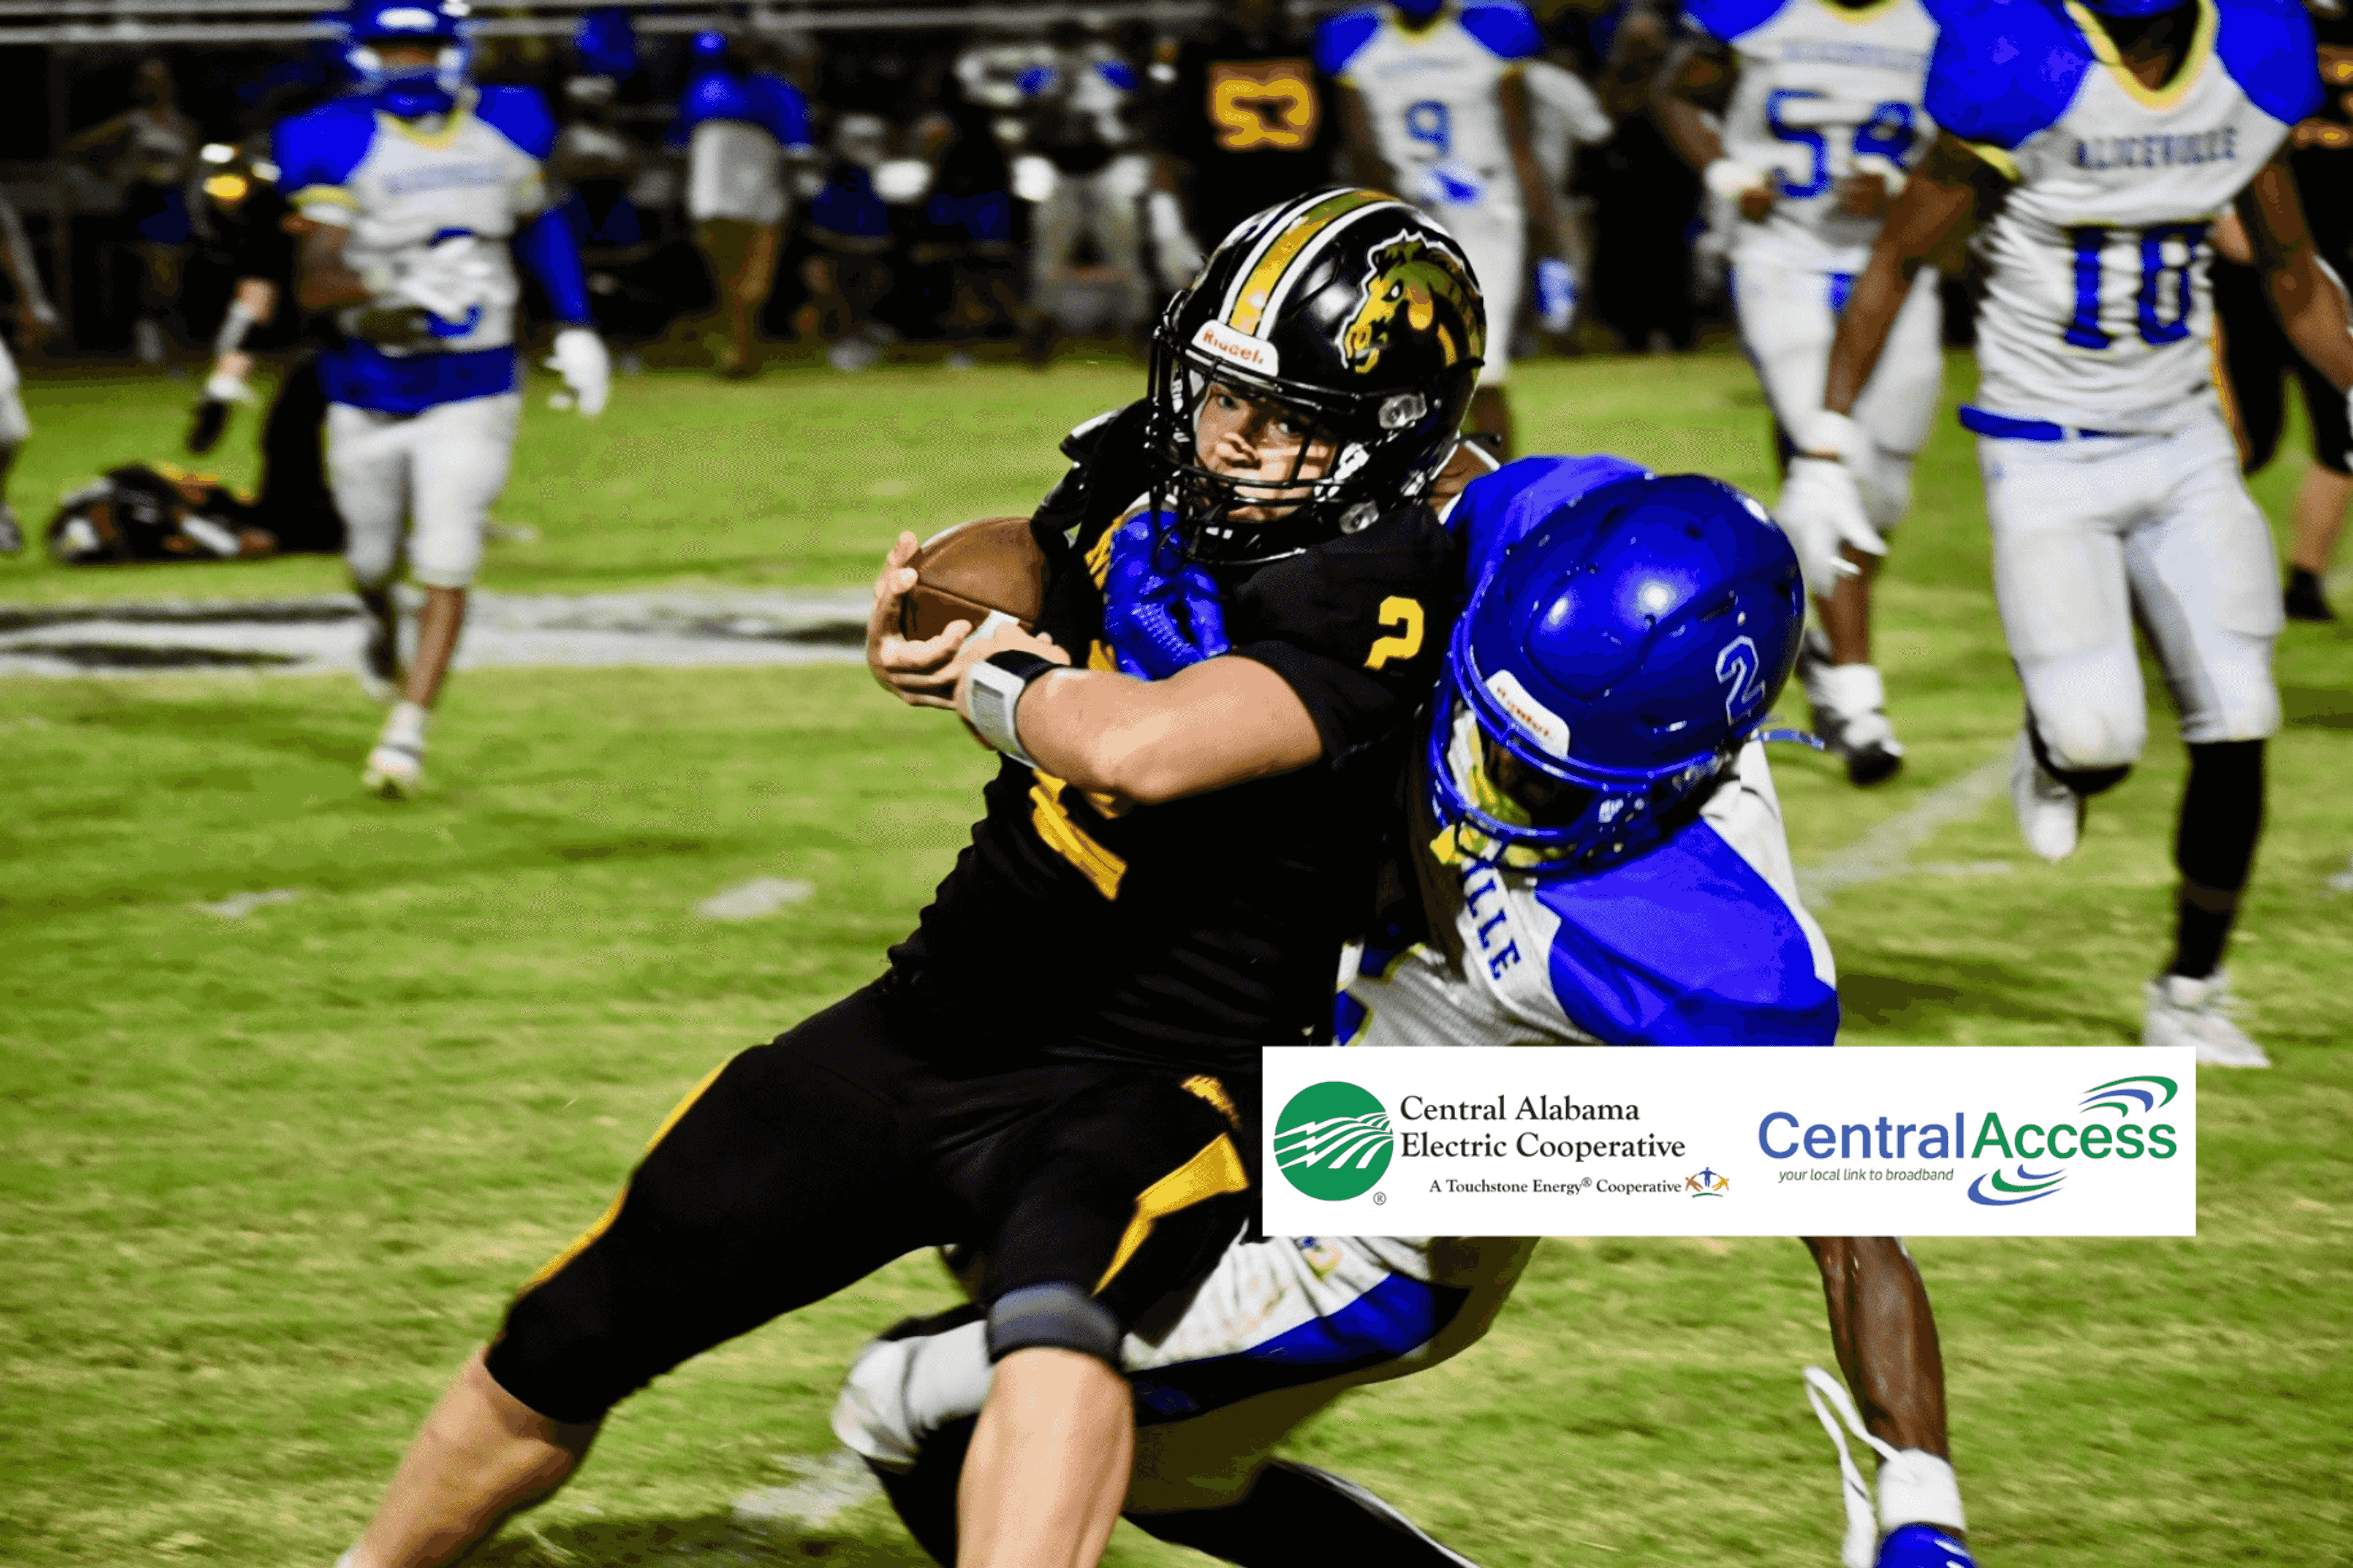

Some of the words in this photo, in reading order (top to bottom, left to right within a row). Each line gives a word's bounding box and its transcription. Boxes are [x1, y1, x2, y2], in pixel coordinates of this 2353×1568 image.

[1406, 100, 1452, 165] 9
[1363, 594, 1425, 671] 2
[1715, 634, 1767, 727] 2
